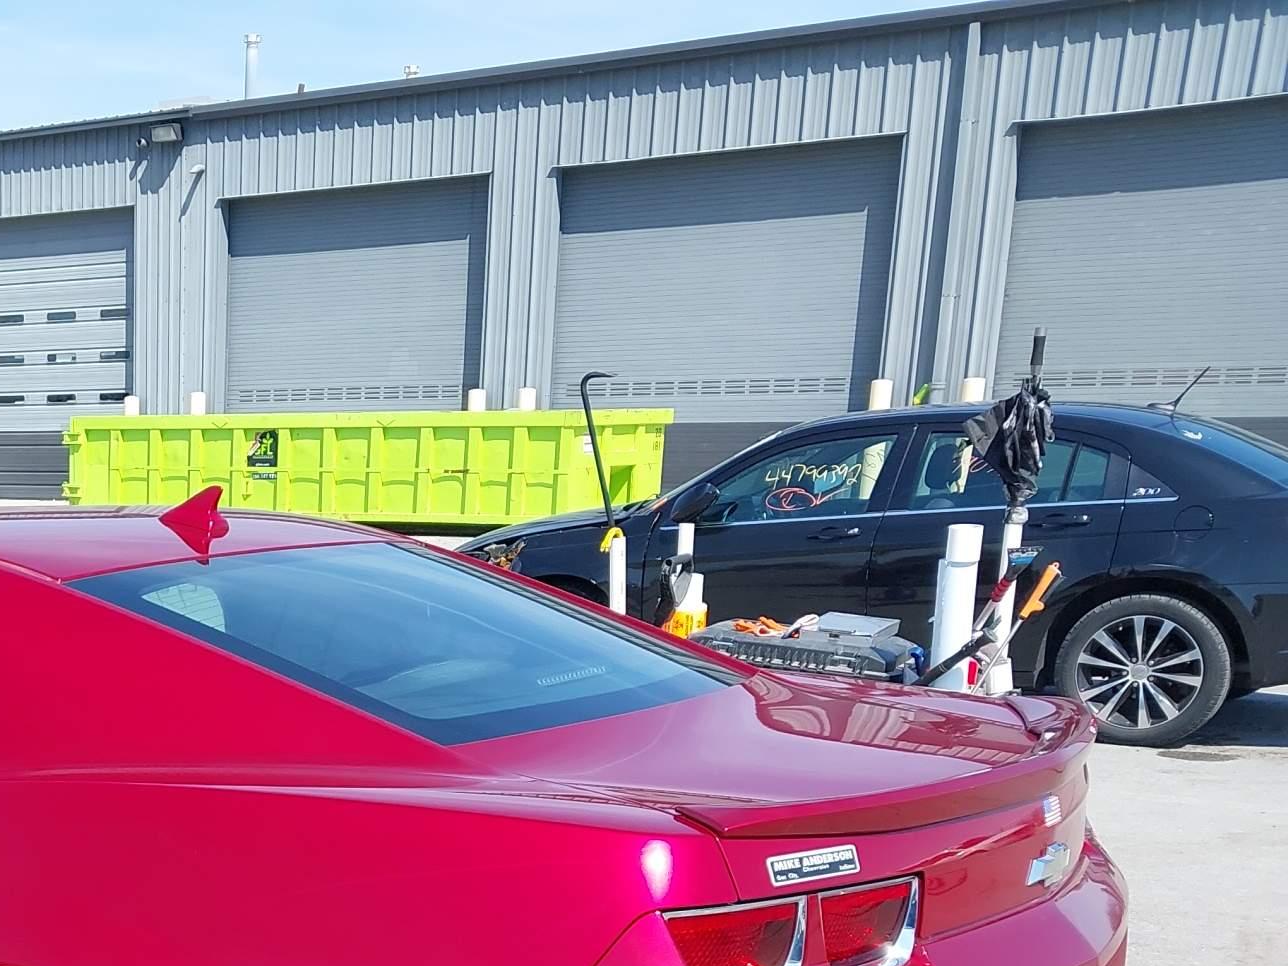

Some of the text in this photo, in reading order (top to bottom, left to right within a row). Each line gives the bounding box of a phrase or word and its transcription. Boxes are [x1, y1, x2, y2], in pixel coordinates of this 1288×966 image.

[765, 463, 862, 490] 44799392
[773, 850, 853, 872] MIKE ANDERSON
